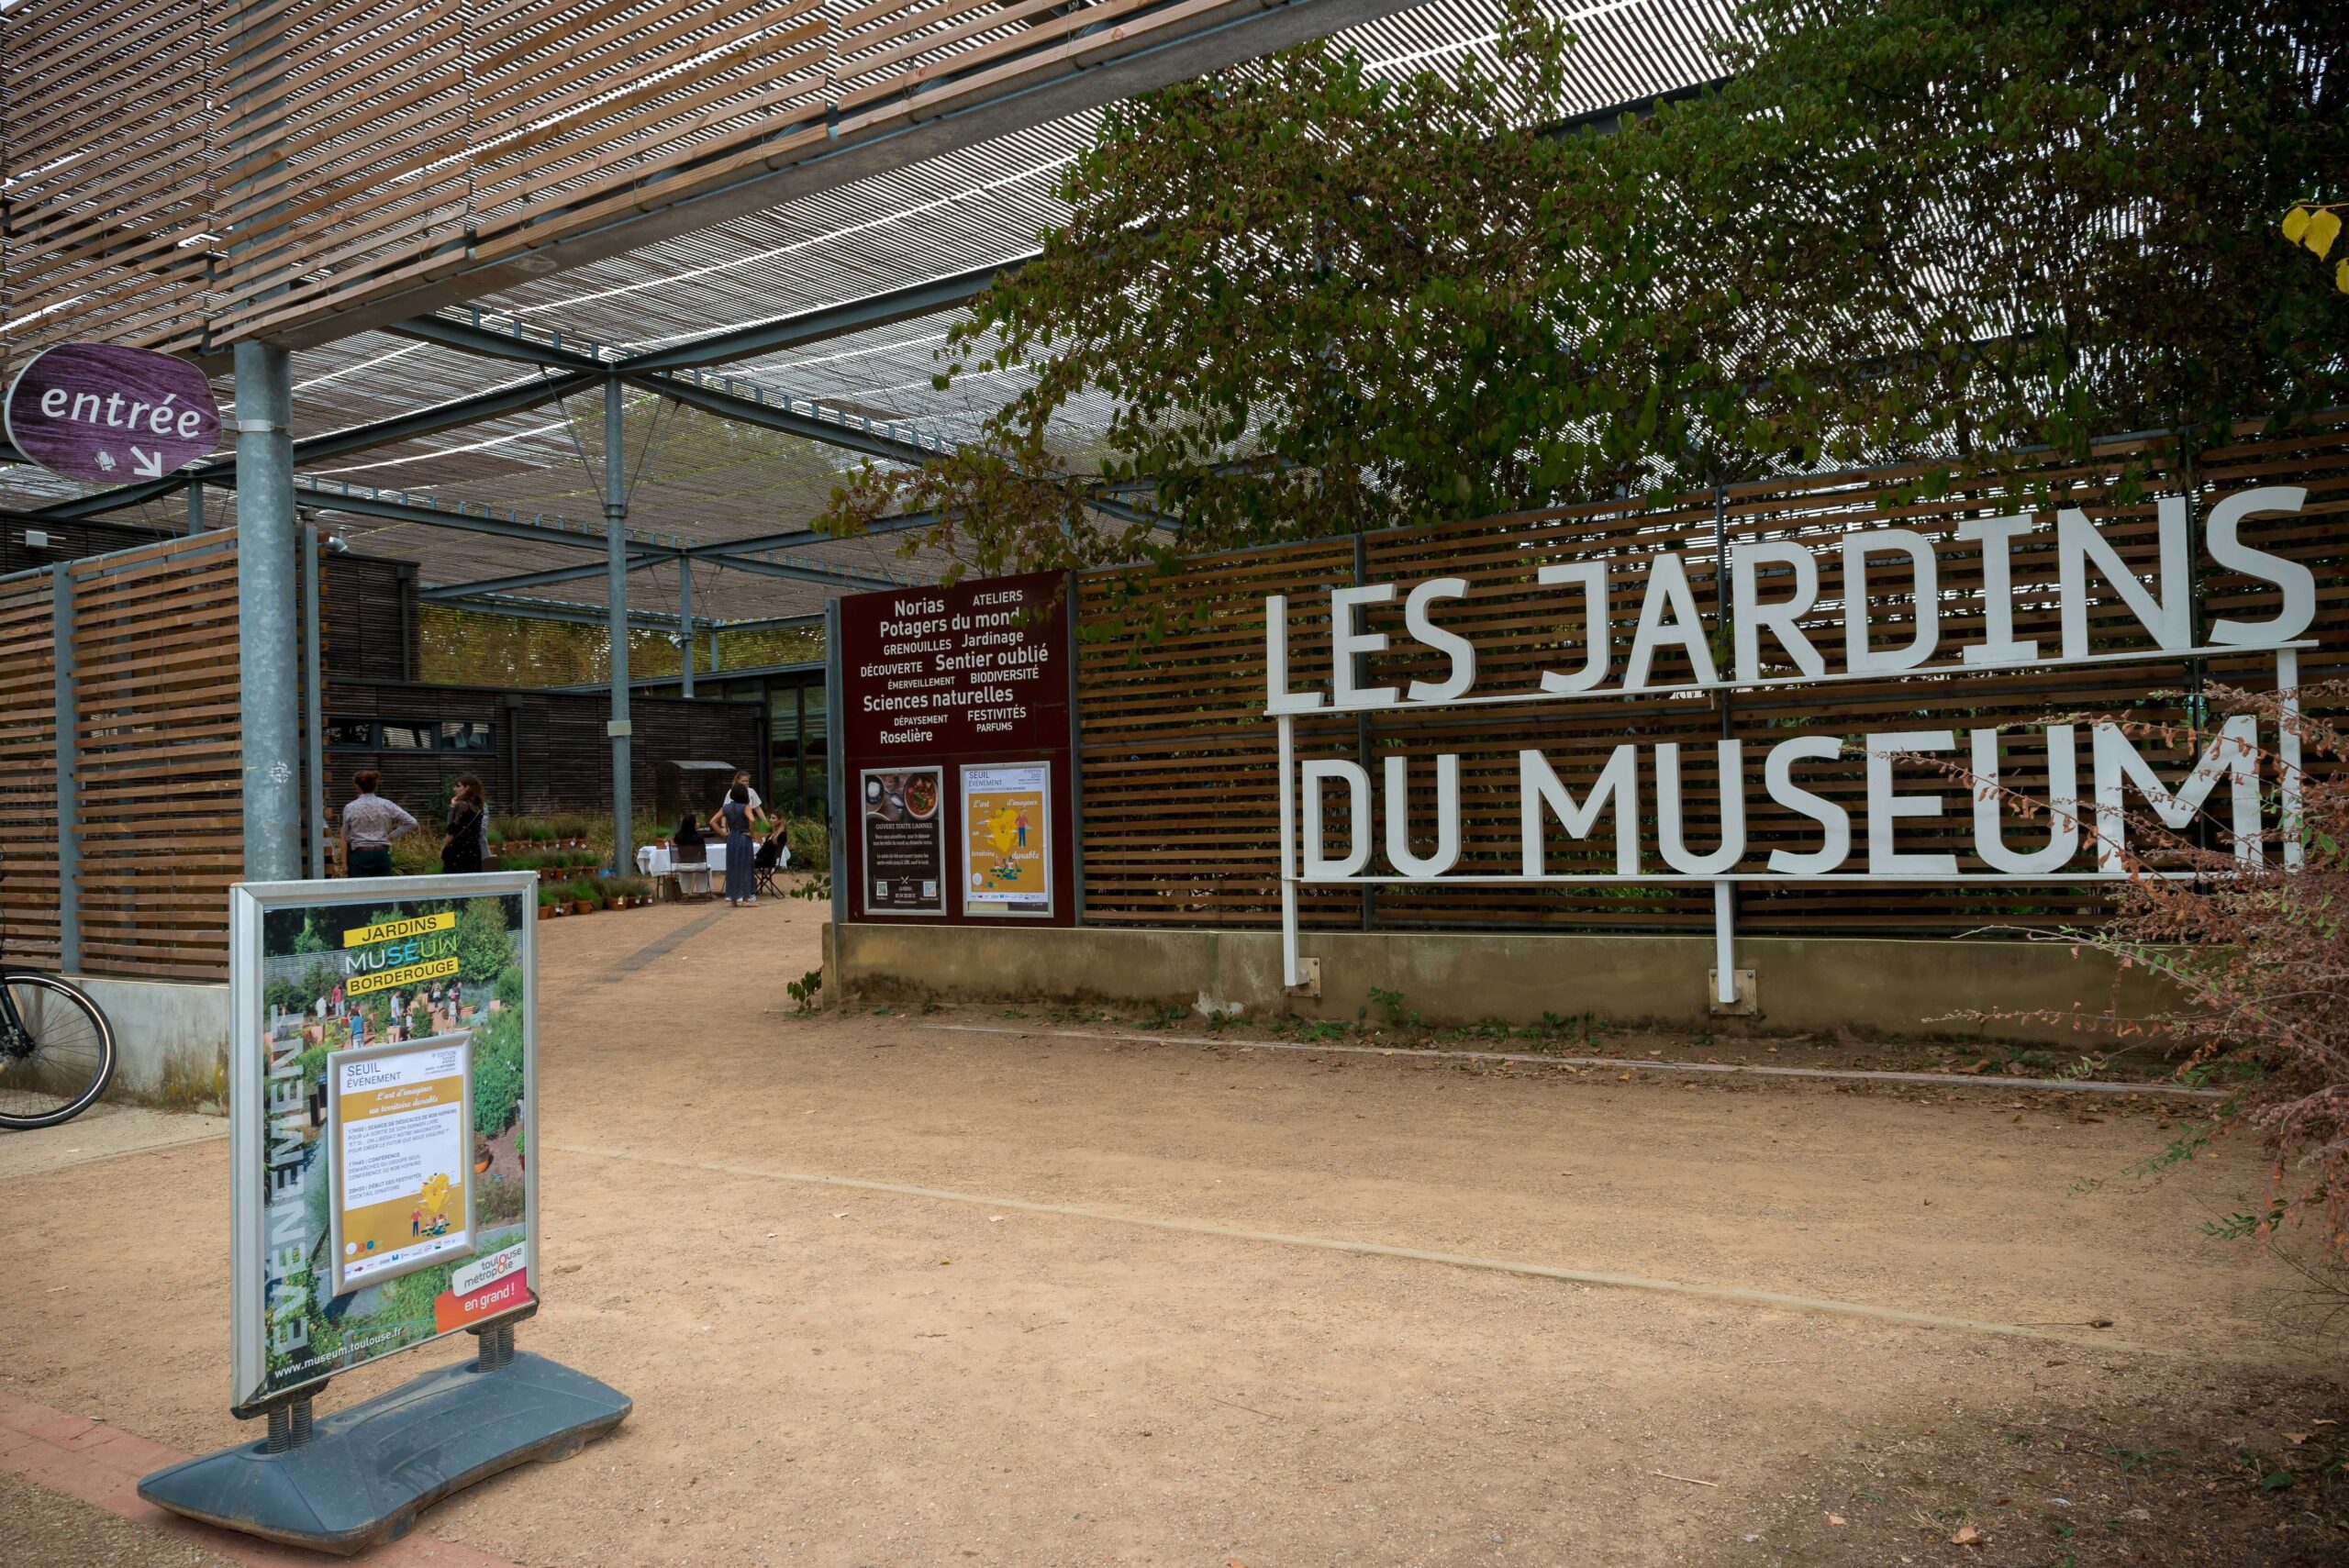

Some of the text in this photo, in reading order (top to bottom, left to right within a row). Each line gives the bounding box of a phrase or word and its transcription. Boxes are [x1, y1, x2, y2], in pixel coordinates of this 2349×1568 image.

[41, 389, 201, 438] entrée
[974, 590, 1023, 606] ATELIERS
[1266, 486, 2316, 710] LES JARDINS
[895, 598, 944, 617] Norias
[880, 618, 947, 639] Potagers
[952, 614, 971, 630] du
[884, 639, 952, 656] GRENOUILLES
[962, 630, 1024, 648] Jardinage
[936, 643, 1049, 671] Sentier oublié
[861, 662, 923, 677] DÉCOUVERTE
[971, 664, 1039, 684] BIODIVERSITÉ
[888, 676, 955, 690] ÉMERVEILLEMENT
[863, 686, 1014, 712] Sciences naturelles
[894, 715, 949, 727] DÉPAYSEMENT
[968, 705, 1027, 721] FESTIVITÉS
[976, 722, 1013, 732] PARFUMS
[880, 728, 933, 744] Roselière
[969, 771, 990, 779] SEUIL
[1302, 715, 2264, 877] DU MUSEUM
[1012, 851, 1040, 859] durable
[362, 917, 437, 941] JARDINS
[351, 961, 454, 992] BORDEROUGE
[348, 1062, 381, 1076] SEUIL
[347, 1072, 401, 1087] ÉVÉNEMENT
[376, 1092, 395, 1101] L'art
[413, 1095, 439, 1106] durable
[482, 1248, 522, 1270] toulouse
[464, 1261, 513, 1288] métropole
[464, 1298, 478, 1311] en
[274, 1327, 403, 1379] www.museum.toulouse.fr
